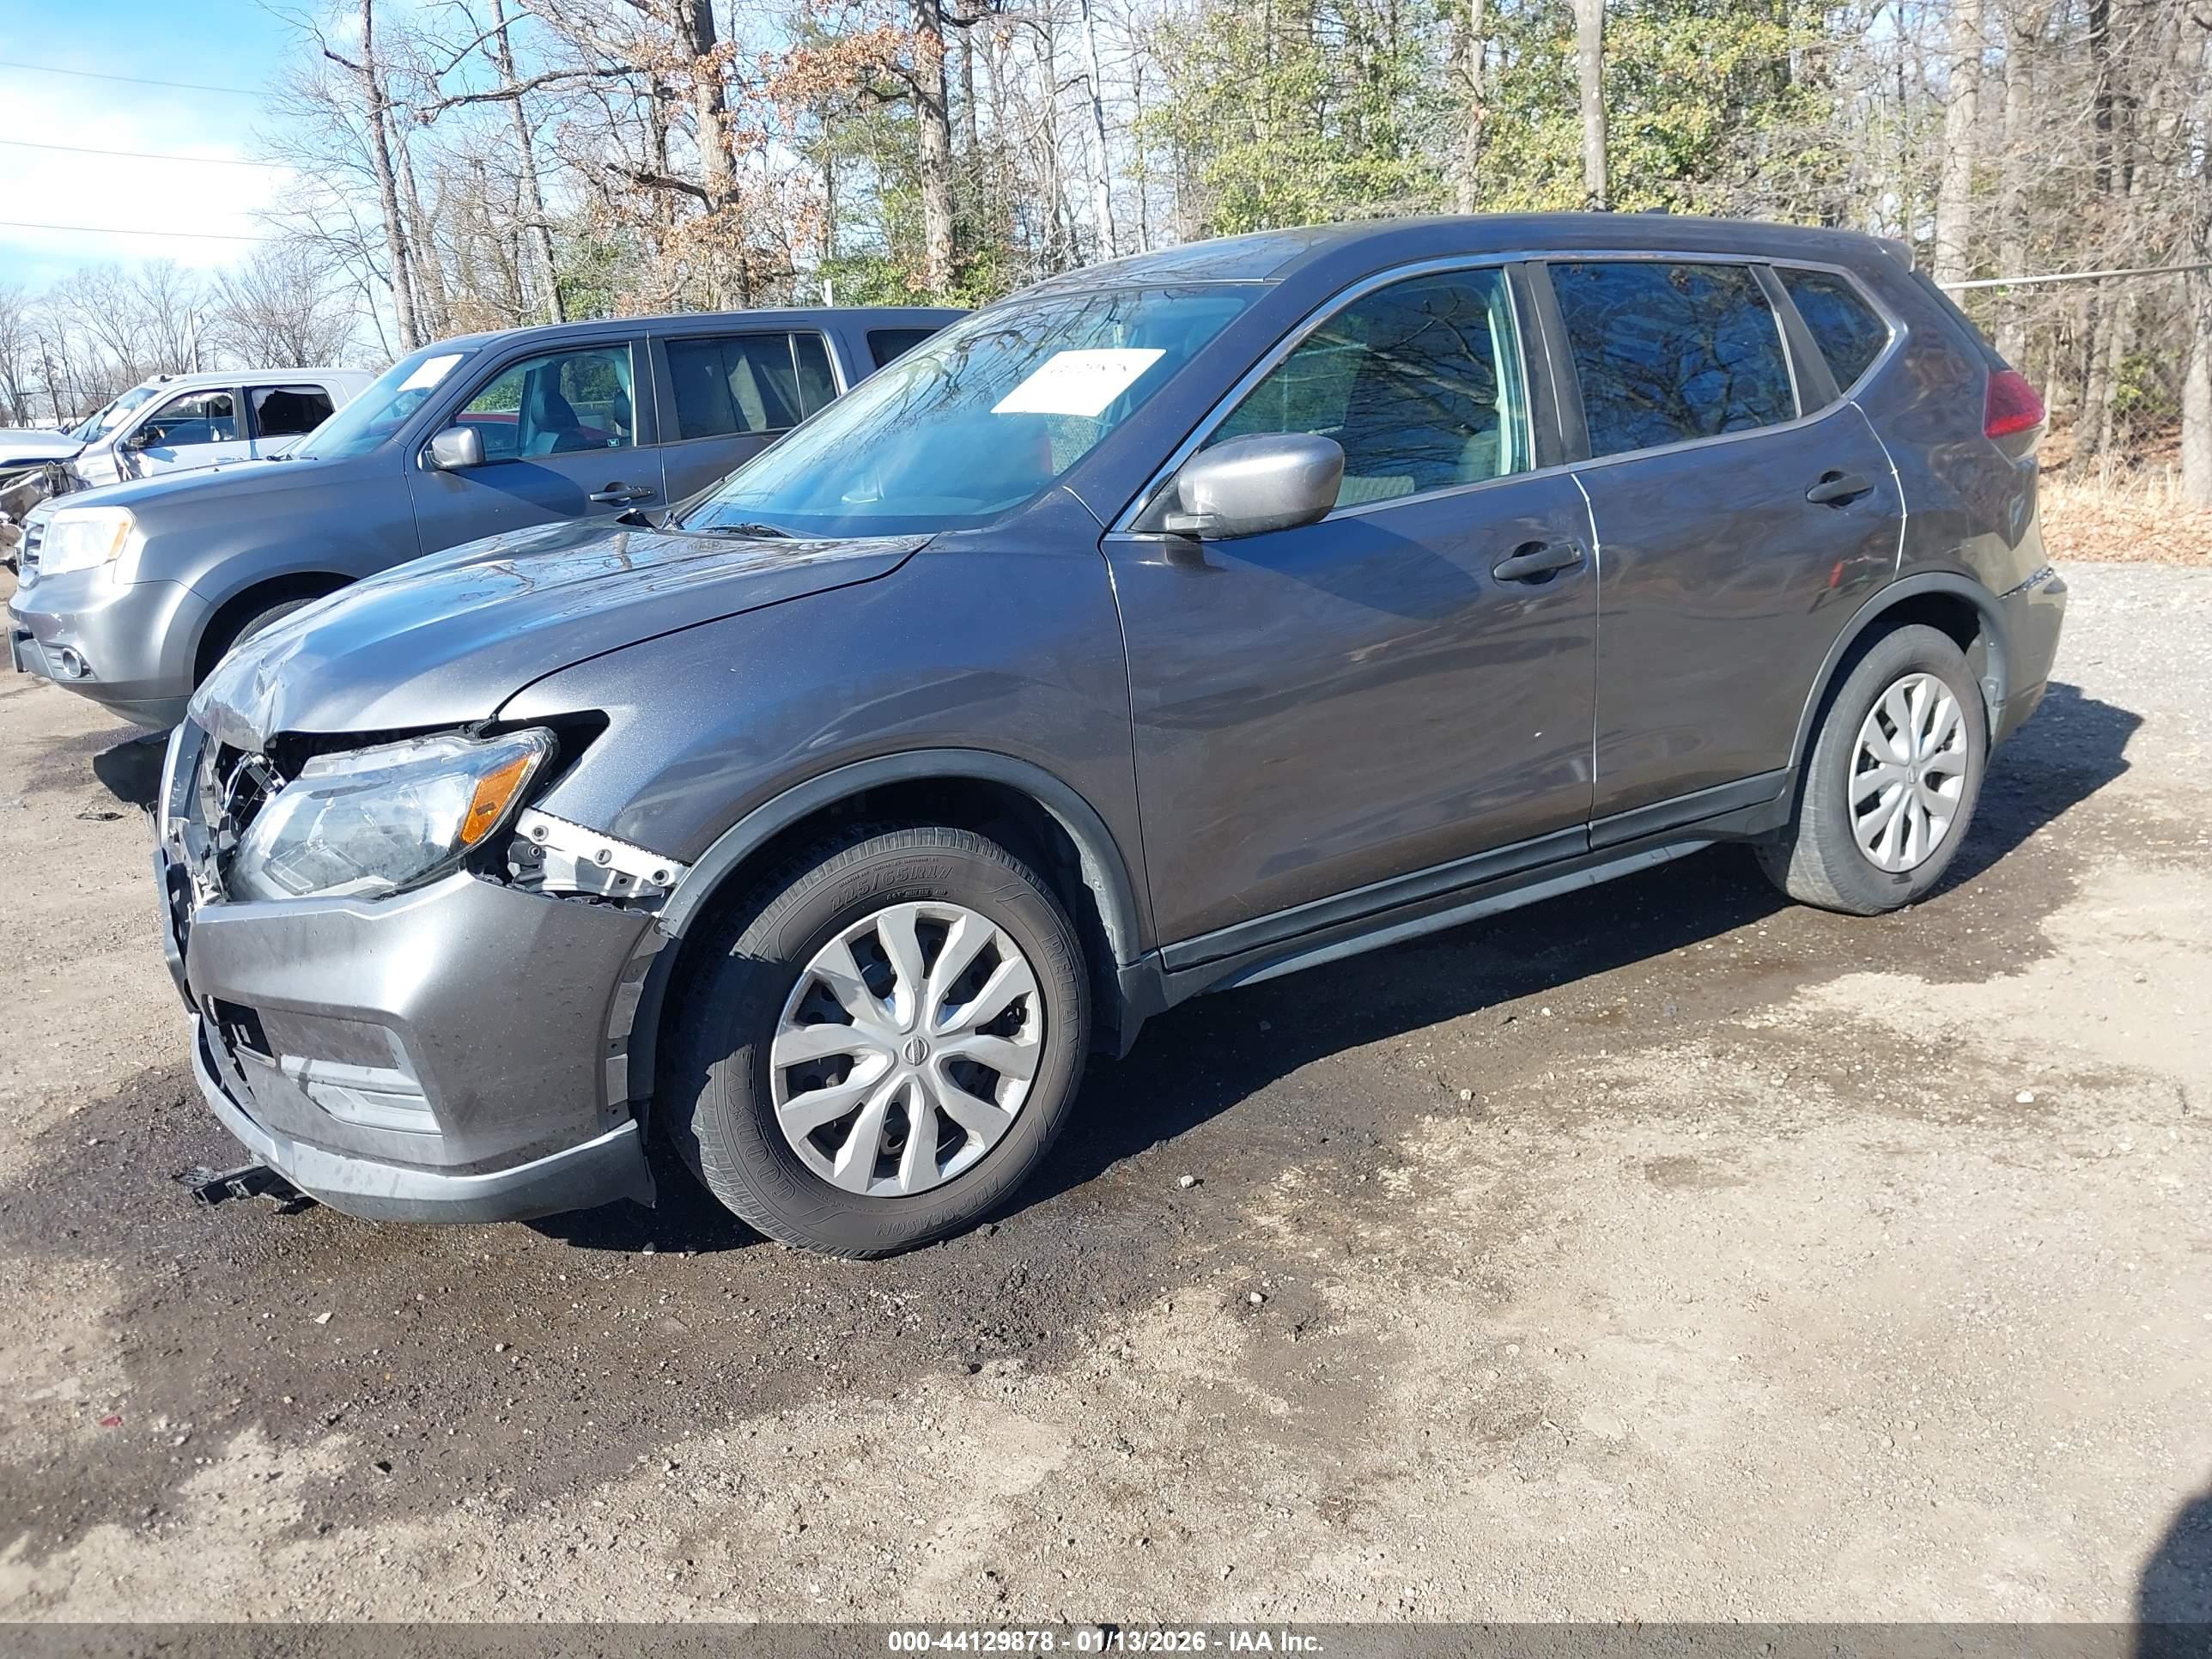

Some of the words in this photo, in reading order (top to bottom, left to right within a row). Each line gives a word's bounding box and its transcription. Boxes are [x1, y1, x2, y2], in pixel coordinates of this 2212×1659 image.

[831, 864, 954, 913] 225/65R17
[727, 1046, 796, 1201] GOODYE
[874, 1173, 1000, 1237] ALL-SEASON
